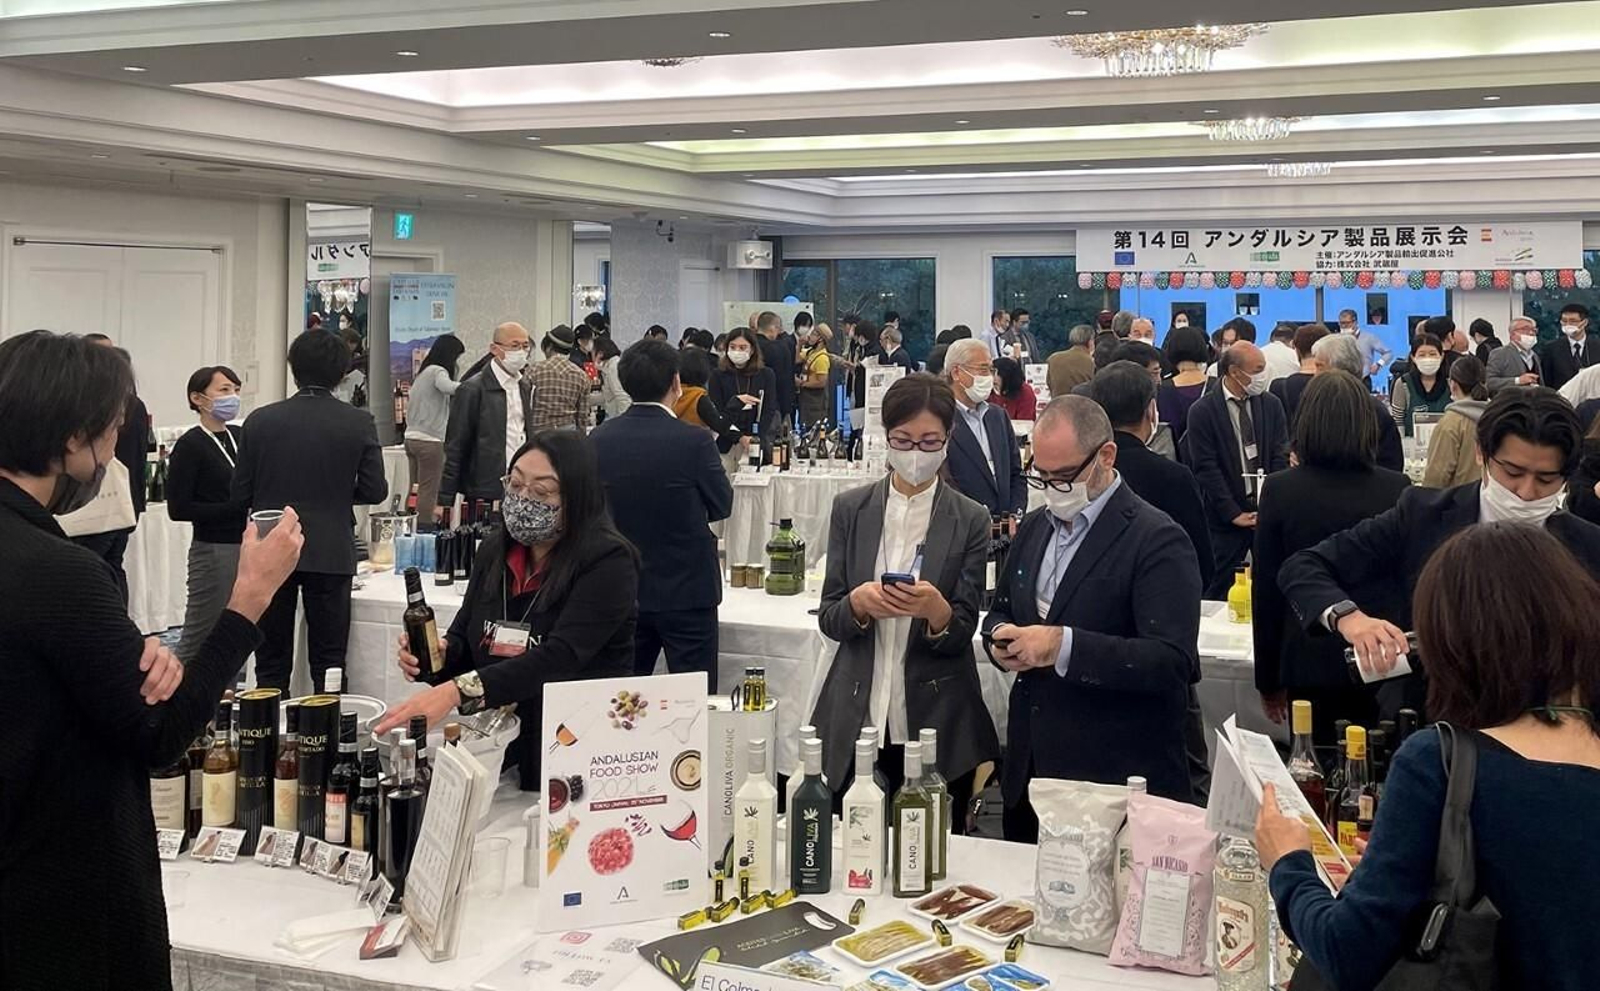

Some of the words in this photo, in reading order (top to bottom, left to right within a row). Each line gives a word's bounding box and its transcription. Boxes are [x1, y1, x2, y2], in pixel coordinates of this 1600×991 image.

[1114, 230, 1190, 249] 第14回
[1205, 225, 1469, 248] アンダルシア製品展示会
[240, 727, 272, 738] TIQUE
[299, 735, 328, 746] TIQUE
[590, 751, 659, 766] ANDALUSIAN
[590, 766, 622, 778] FOOD
[626, 763, 659, 775] SHOW
[724, 770, 734, 816] CANOLIVA
[701, 974, 715, 991] El
